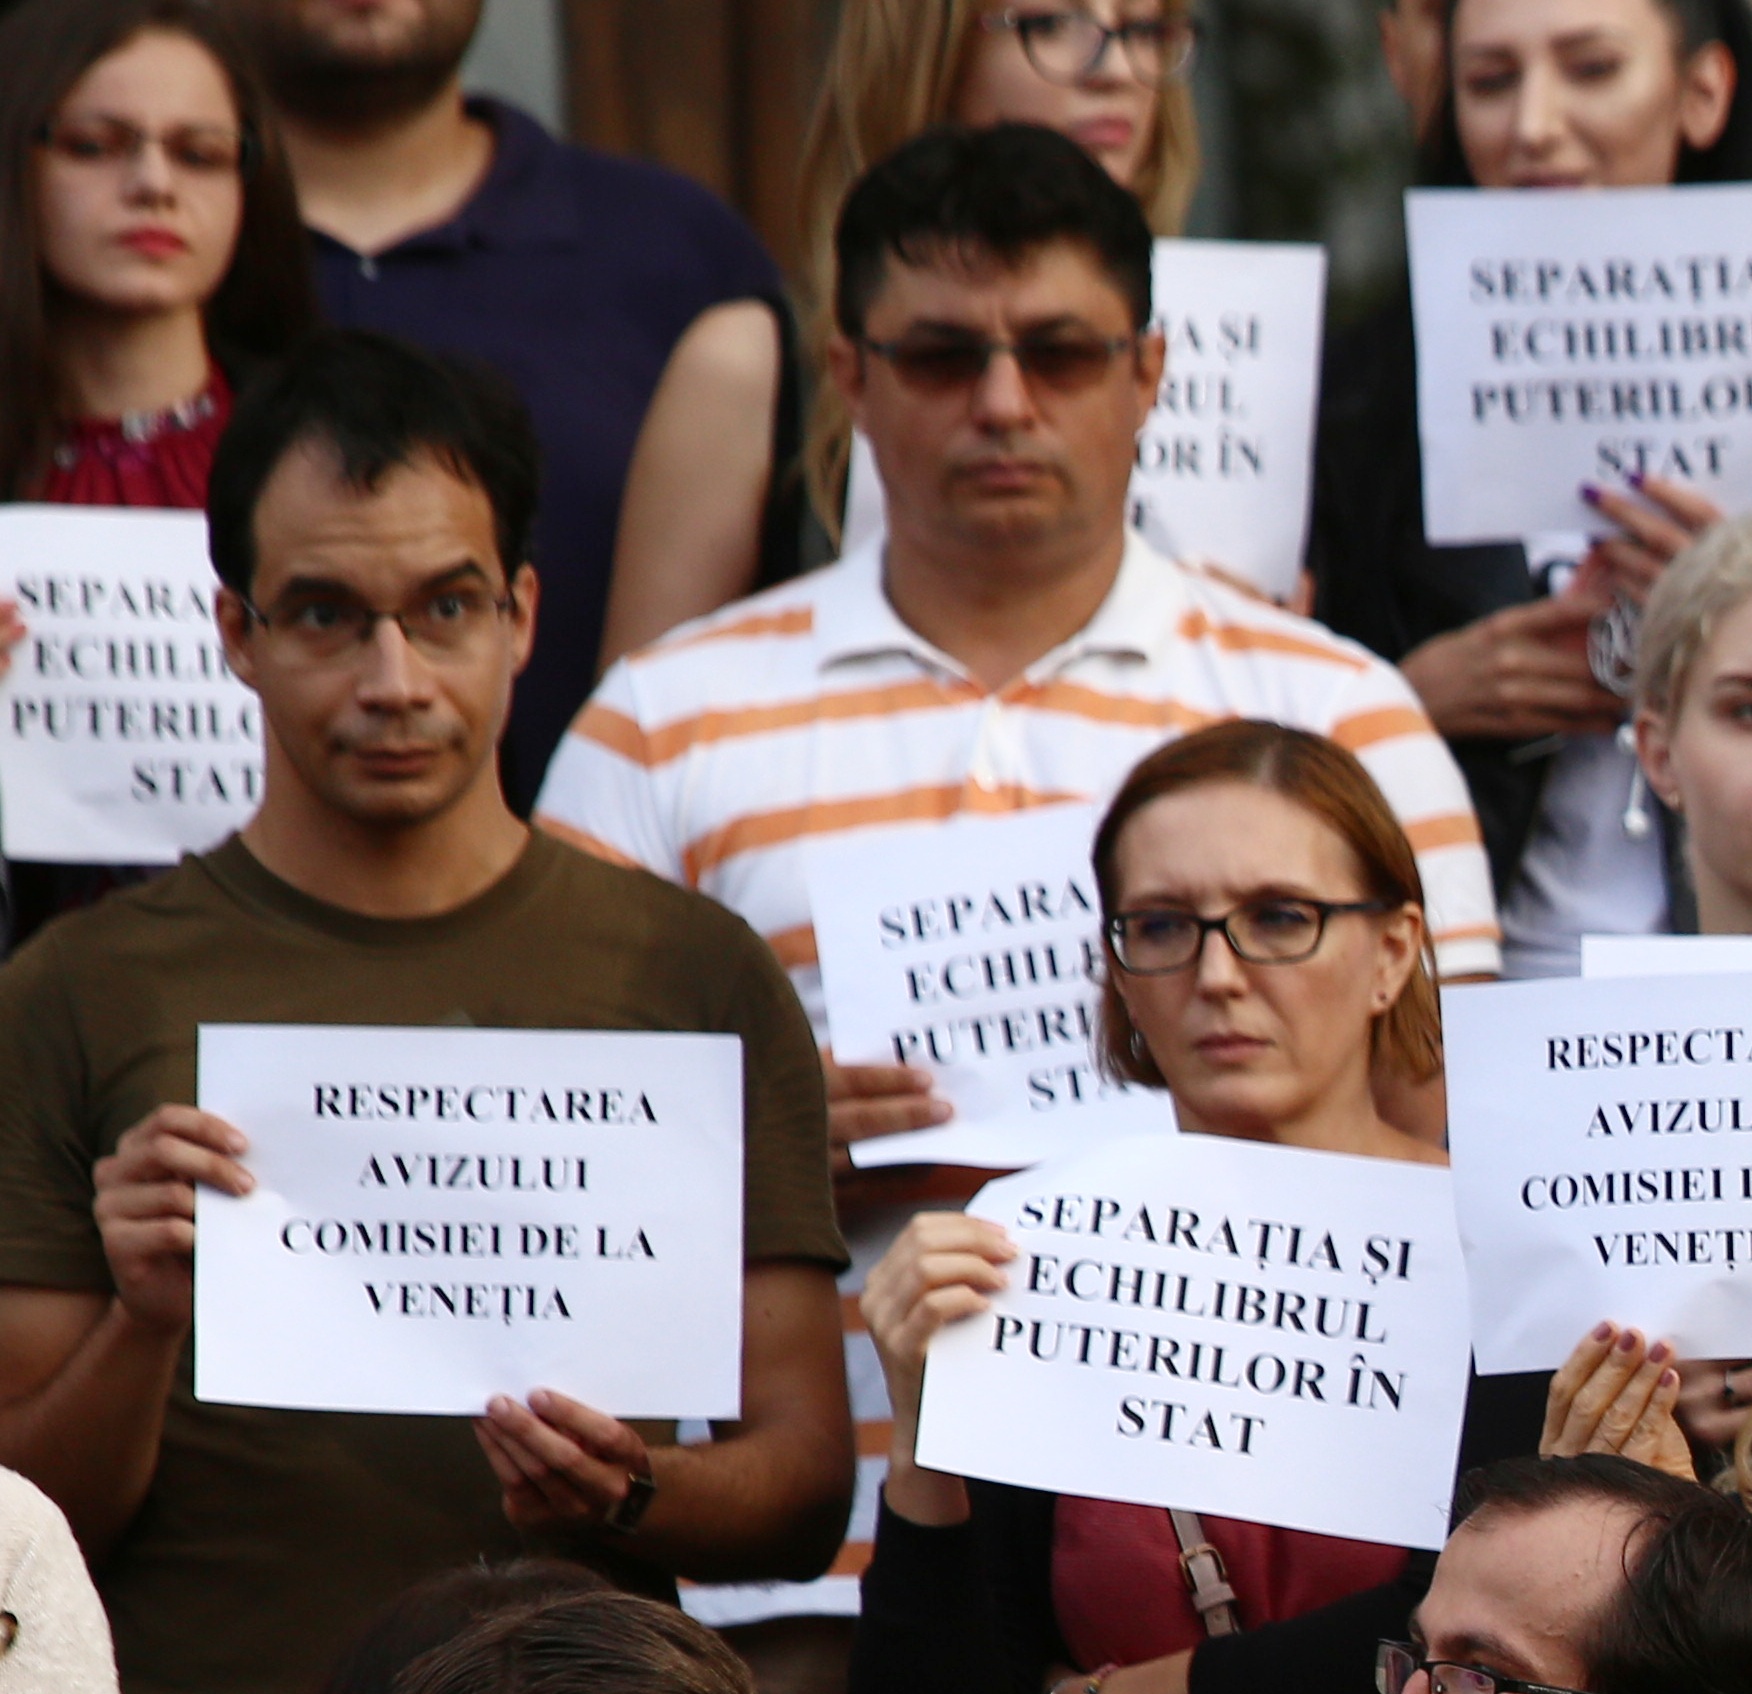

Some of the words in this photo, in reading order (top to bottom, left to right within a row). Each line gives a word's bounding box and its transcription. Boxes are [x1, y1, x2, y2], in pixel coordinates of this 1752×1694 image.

[1594, 437, 1730, 478] STAT
[33, 637, 229, 678] ECHILI
[314, 1085, 657, 1123] RESPECTAREA
[361, 1154, 586, 1190] AVIZULUI
[1522, 1168, 1722, 1210] COMISIEI
[281, 1221, 501, 1256] COMISIEI
[520, 1224, 578, 1257] DE
[597, 1226, 655, 1259] LA
[1018, 1197, 1342, 1271] SEPARAȚIA
[1362, 1237, 1412, 1286] ȘI
[365, 1283, 571, 1326] VENEȚIA
[1028, 1253, 1390, 1344] ECHILIBRUL
[994, 1314, 1326, 1402] PUTERILOR
[1347, 1353, 1405, 1411] ÎN
[1117, 1398, 1265, 1455] STAT
